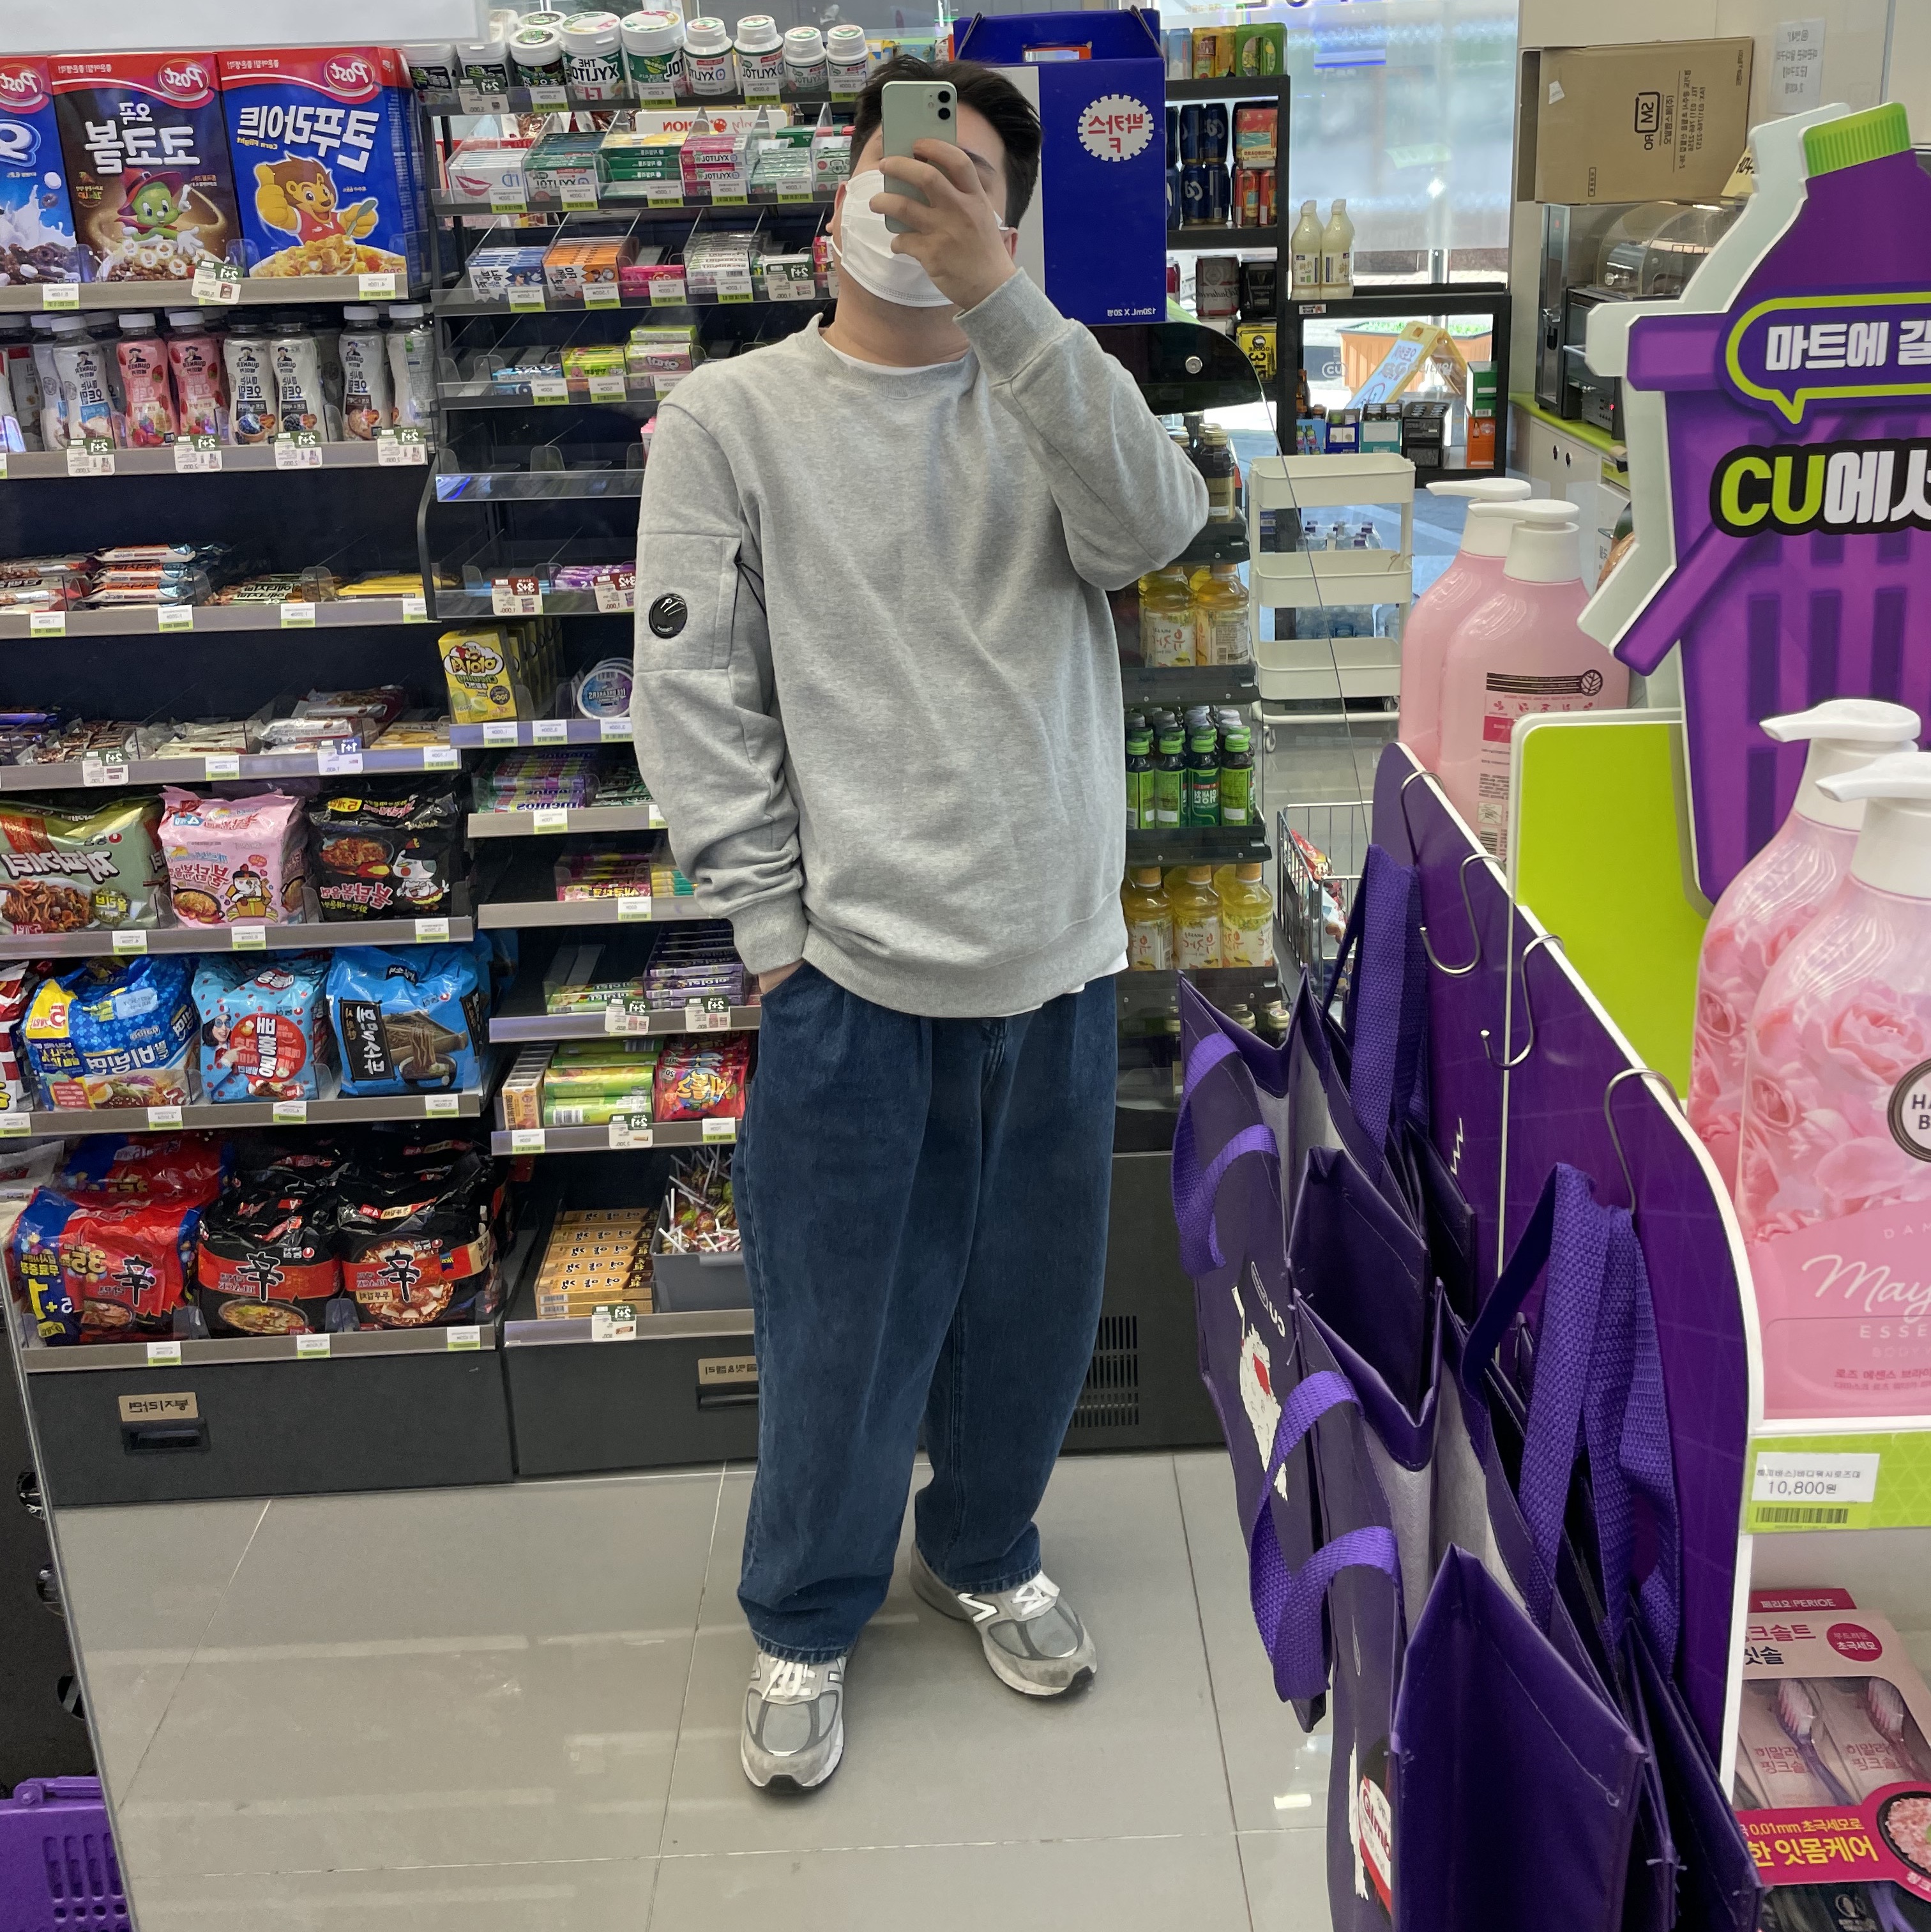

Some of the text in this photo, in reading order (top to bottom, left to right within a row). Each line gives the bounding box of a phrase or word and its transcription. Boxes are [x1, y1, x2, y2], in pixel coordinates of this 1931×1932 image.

[1765, 321, 1890, 371] 마트에
[1768, 1481, 1836, 1496] 10,800원
[1761, 1599, 1836, 1608] 페리오 PERIOE
[1746, 1624, 1816, 1642] 크솔트
[1837, 1641, 1878, 1650] 초극세모
[1755, 1746, 1799, 1758] 히말라
[1749, 1818, 1865, 1836] 0.01mm 초극세모로
[1775, 1836, 1879, 1866] 잇몸케어
